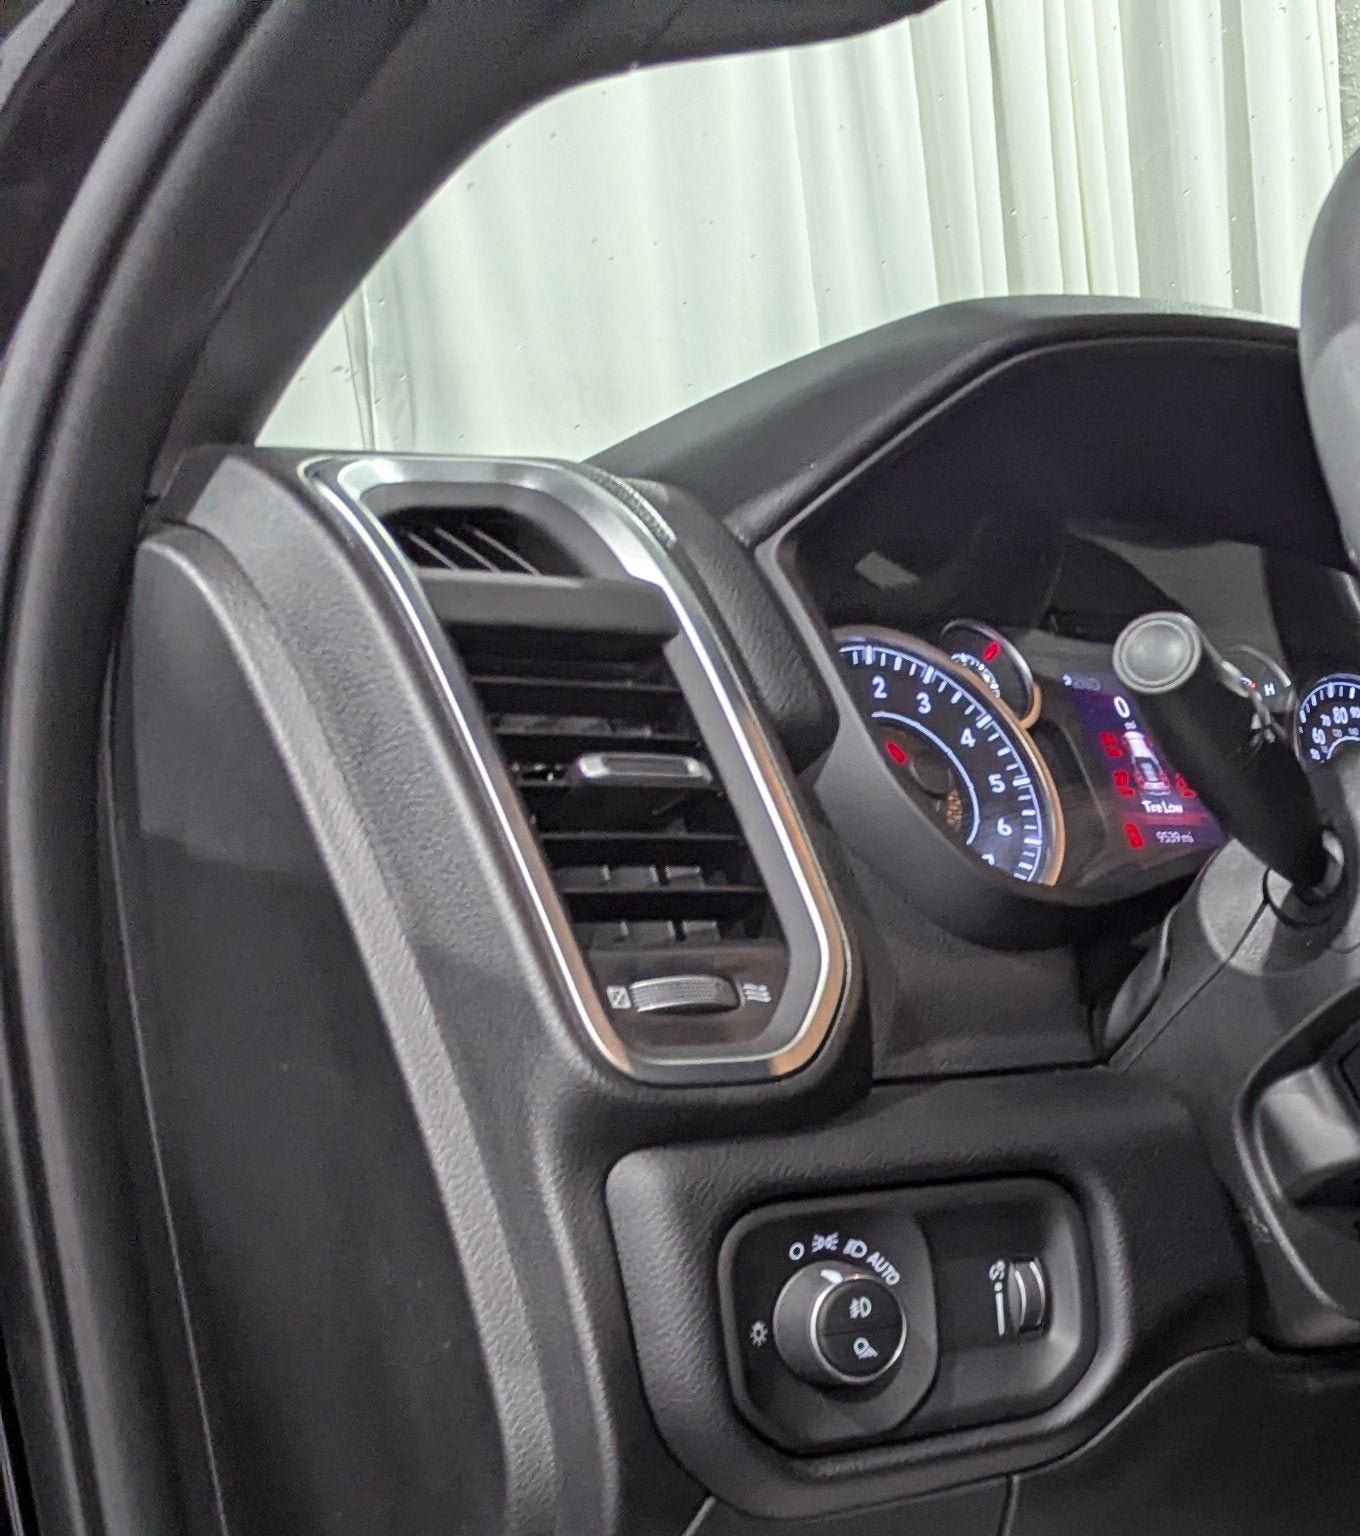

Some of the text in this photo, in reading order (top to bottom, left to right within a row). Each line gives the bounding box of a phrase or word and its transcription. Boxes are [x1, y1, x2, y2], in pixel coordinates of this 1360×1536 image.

[872, 676, 888, 698] 2
[1263, 682, 1276, 697] H
[916, 692, 932, 714] 3
[1113, 696, 1131, 719] 0
[1332, 706, 1348, 724] 80
[960, 728, 976, 748] 4
[988, 773, 1005, 793] 5
[997, 818, 1012, 836] 6
[866, 1252, 901, 1286] AUTO
